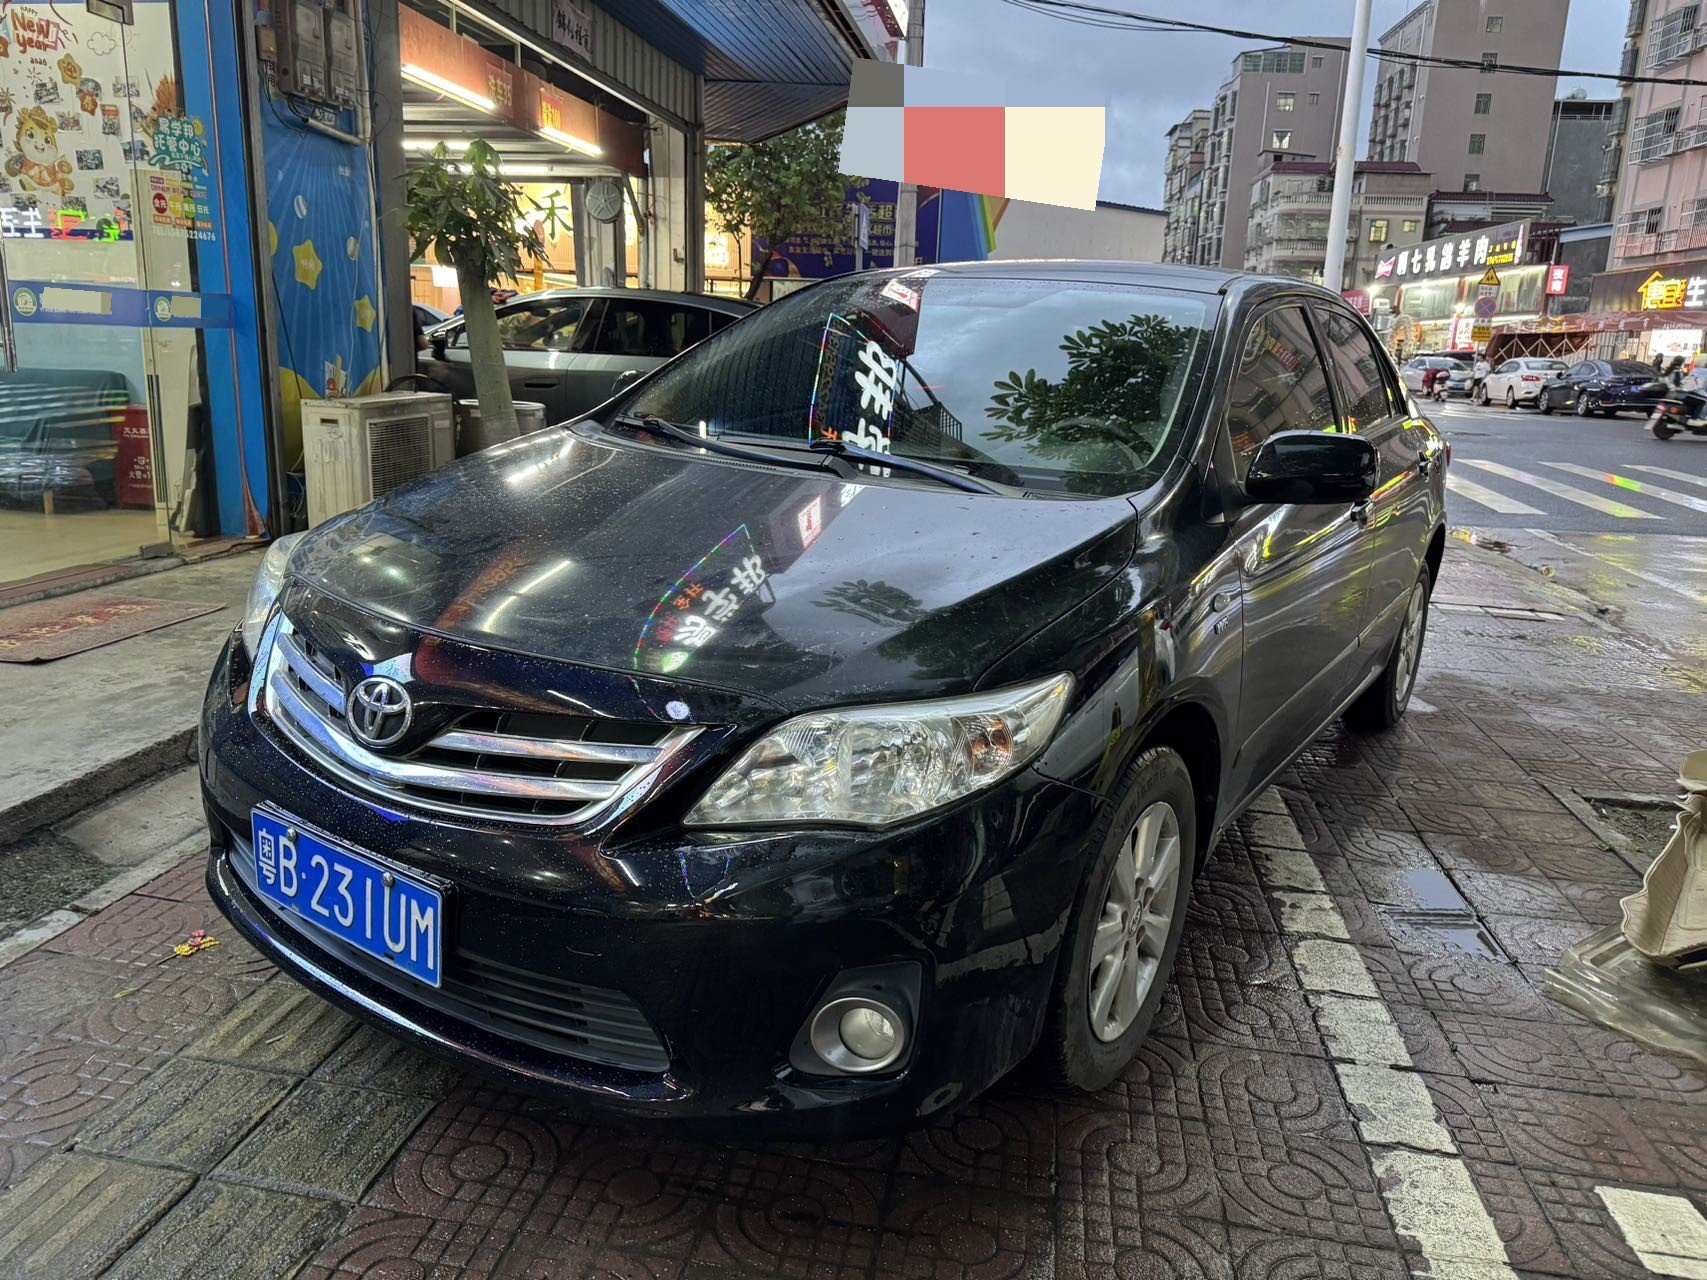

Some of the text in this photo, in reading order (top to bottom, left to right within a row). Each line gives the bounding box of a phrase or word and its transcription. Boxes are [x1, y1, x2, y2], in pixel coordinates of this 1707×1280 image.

[10, 8, 50, 38] New
[16, 33, 48, 54] year
[158, 116, 195, 138] 易学邦
